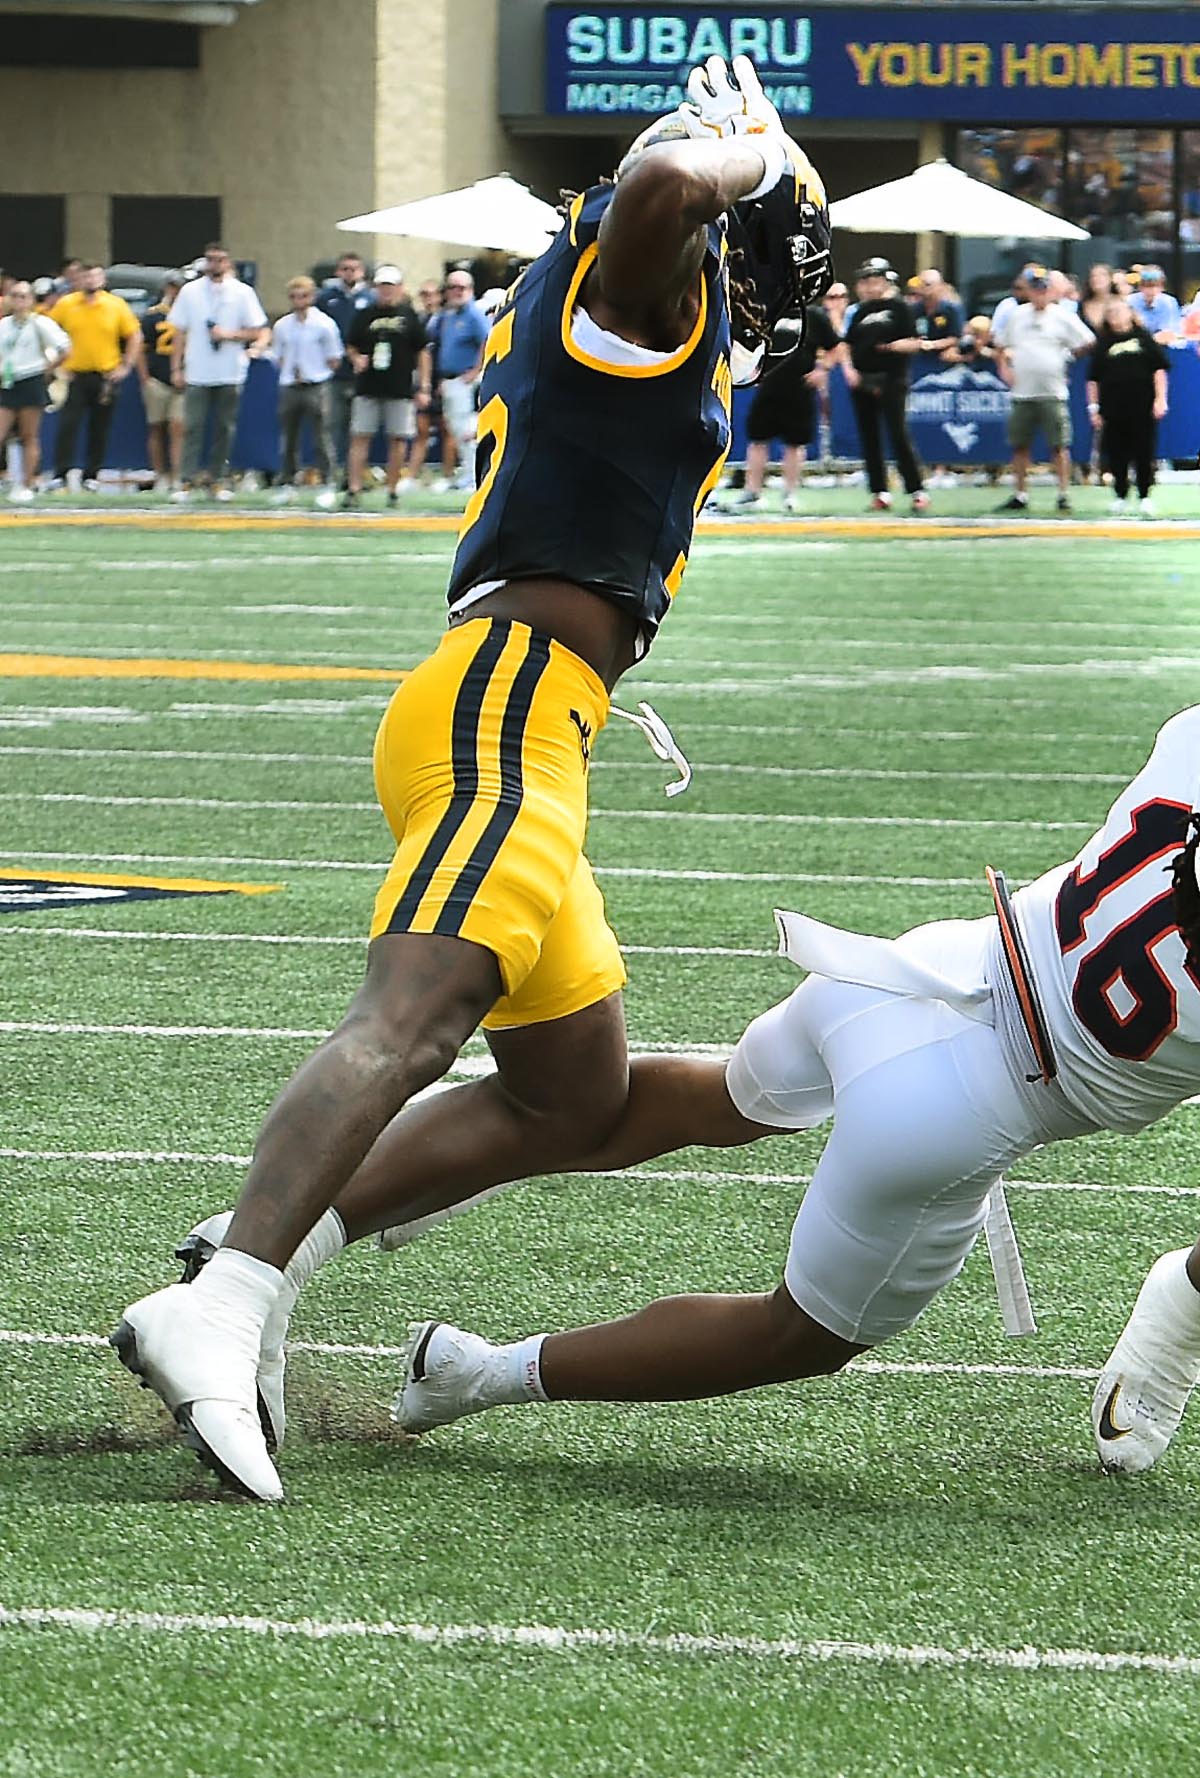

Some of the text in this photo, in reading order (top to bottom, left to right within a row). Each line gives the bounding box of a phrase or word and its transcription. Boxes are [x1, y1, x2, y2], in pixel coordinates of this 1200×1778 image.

[566, 15, 812, 65] SUBARU
[846, 42, 990, 87] YOUR
[566, 83, 812, 115] MORGAWN
